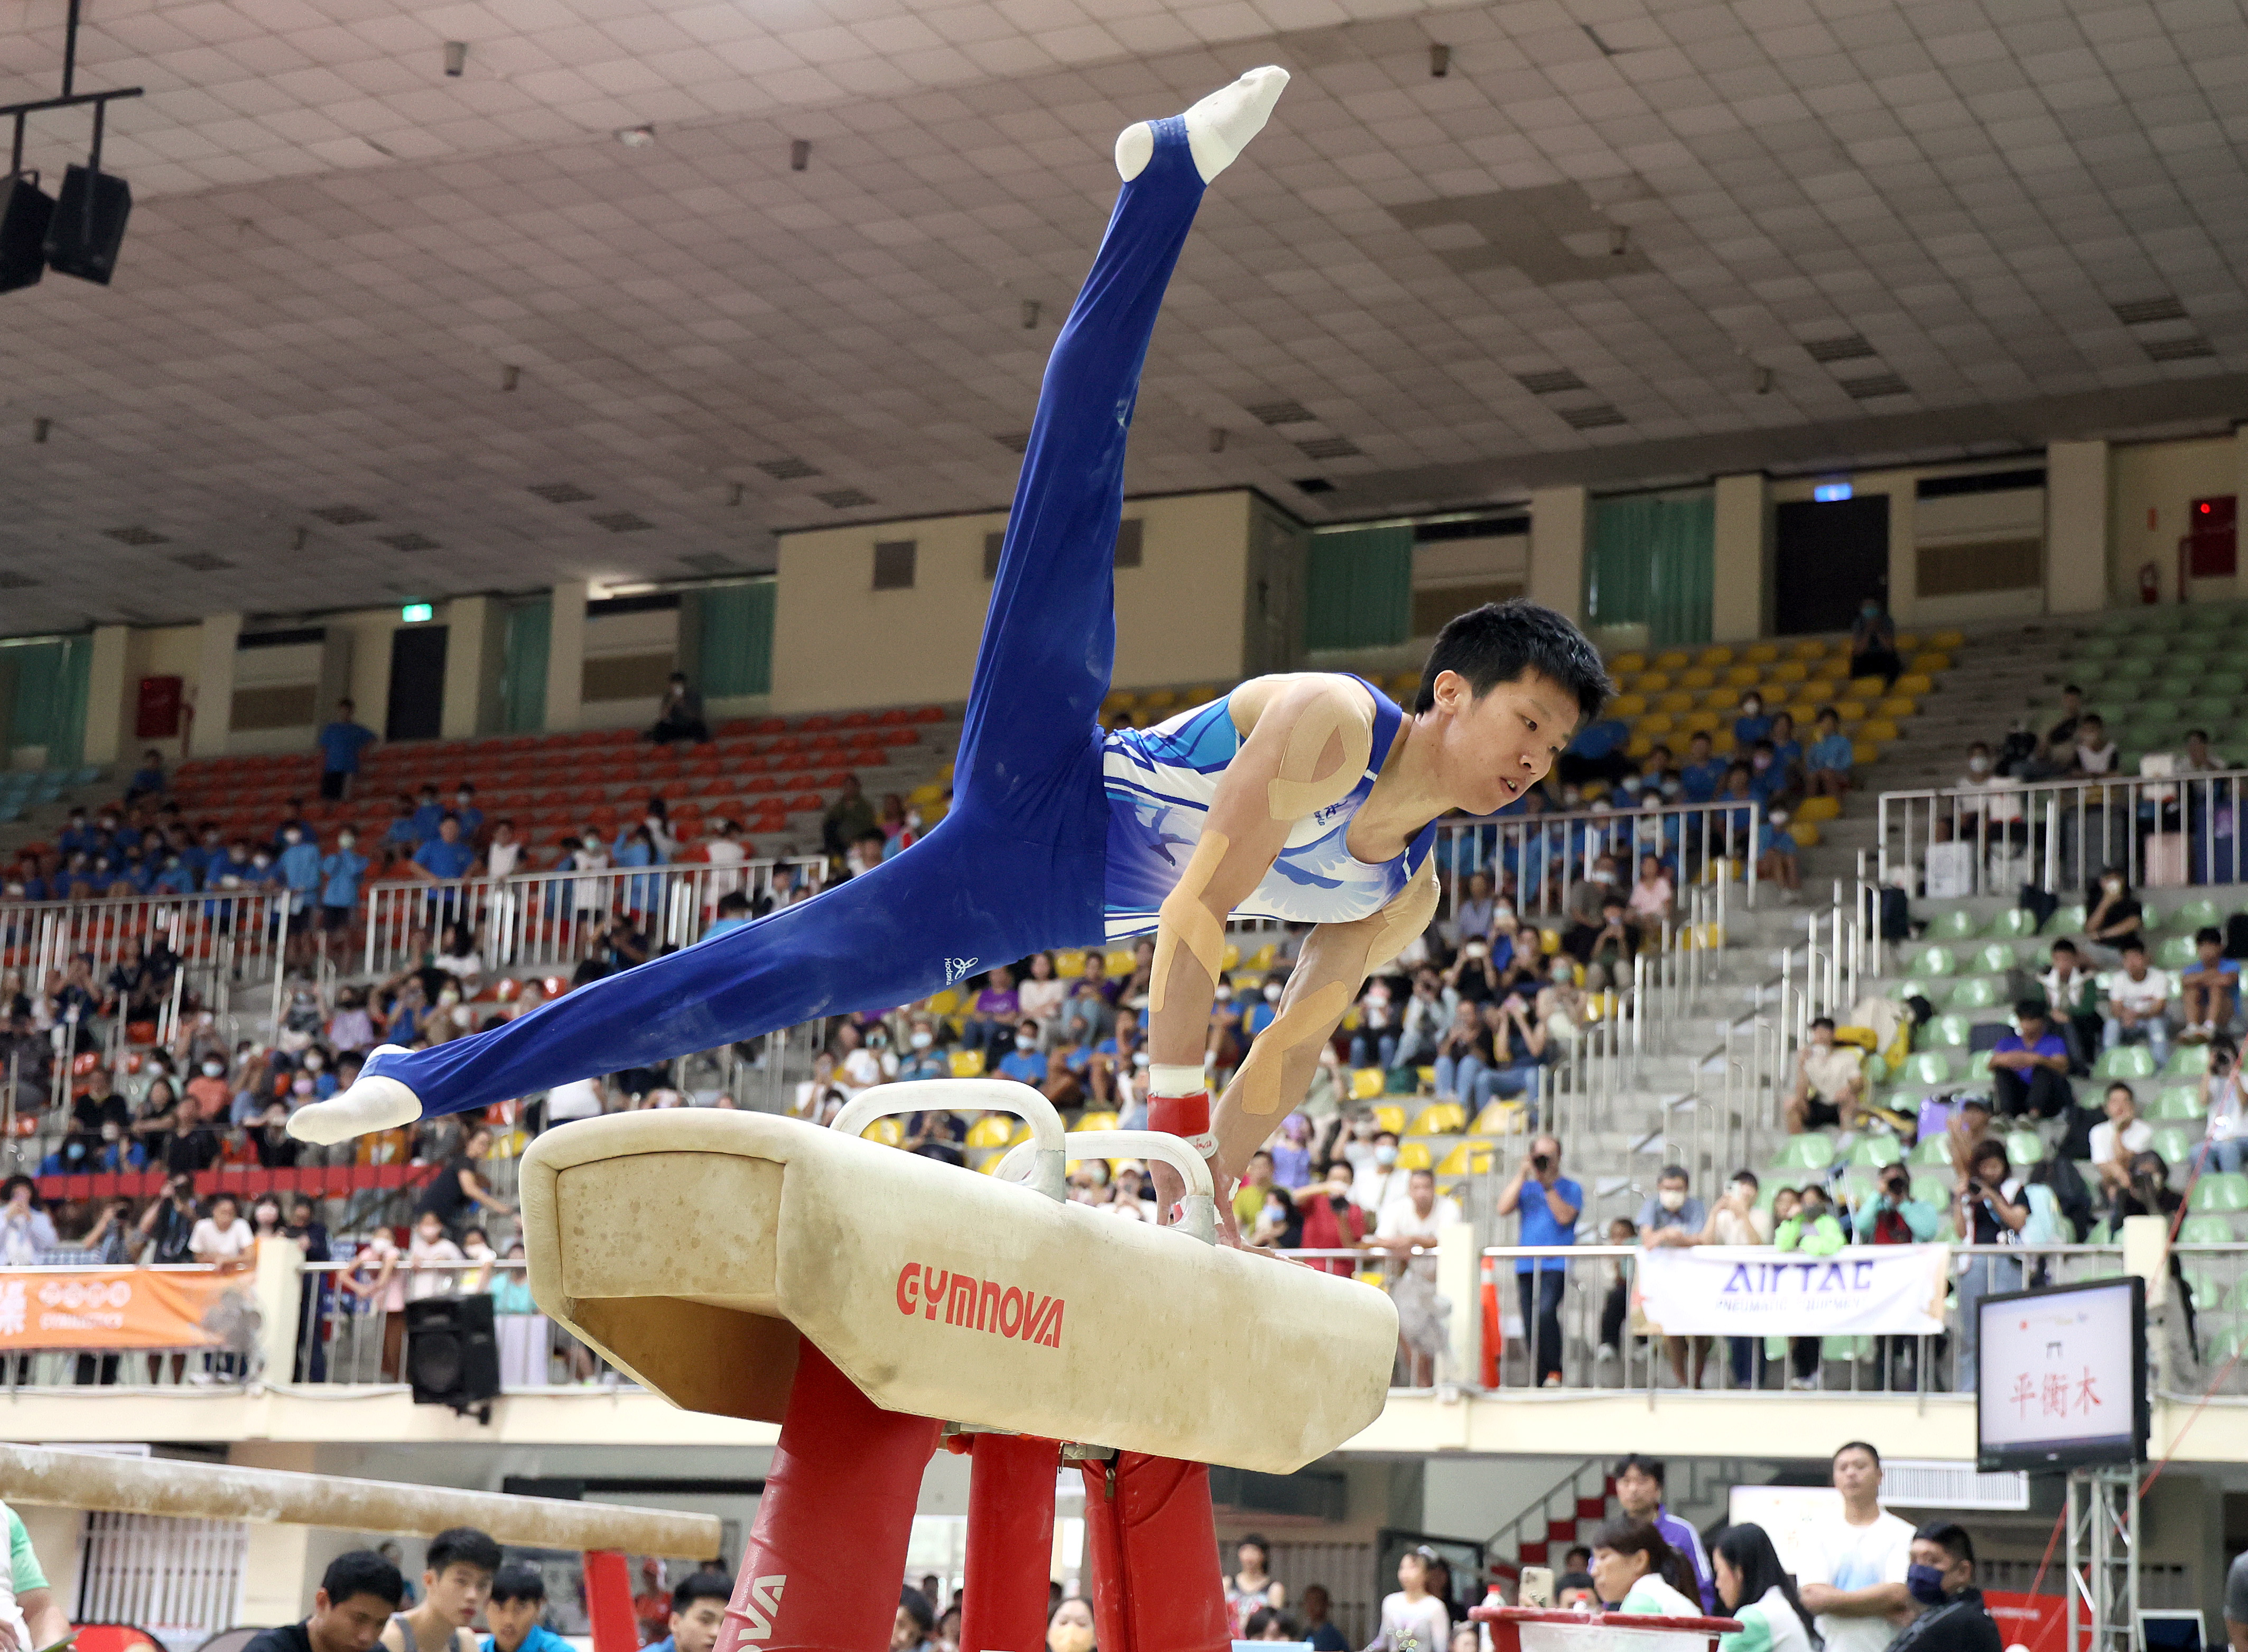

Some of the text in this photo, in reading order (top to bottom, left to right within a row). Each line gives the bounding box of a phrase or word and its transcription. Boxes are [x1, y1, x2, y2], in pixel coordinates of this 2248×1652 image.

[897, 1262, 1065, 1348] GYMNOVA
[2010, 1365, 2102, 1420] 平衡木
[737, 1575, 787, 1652] VA
